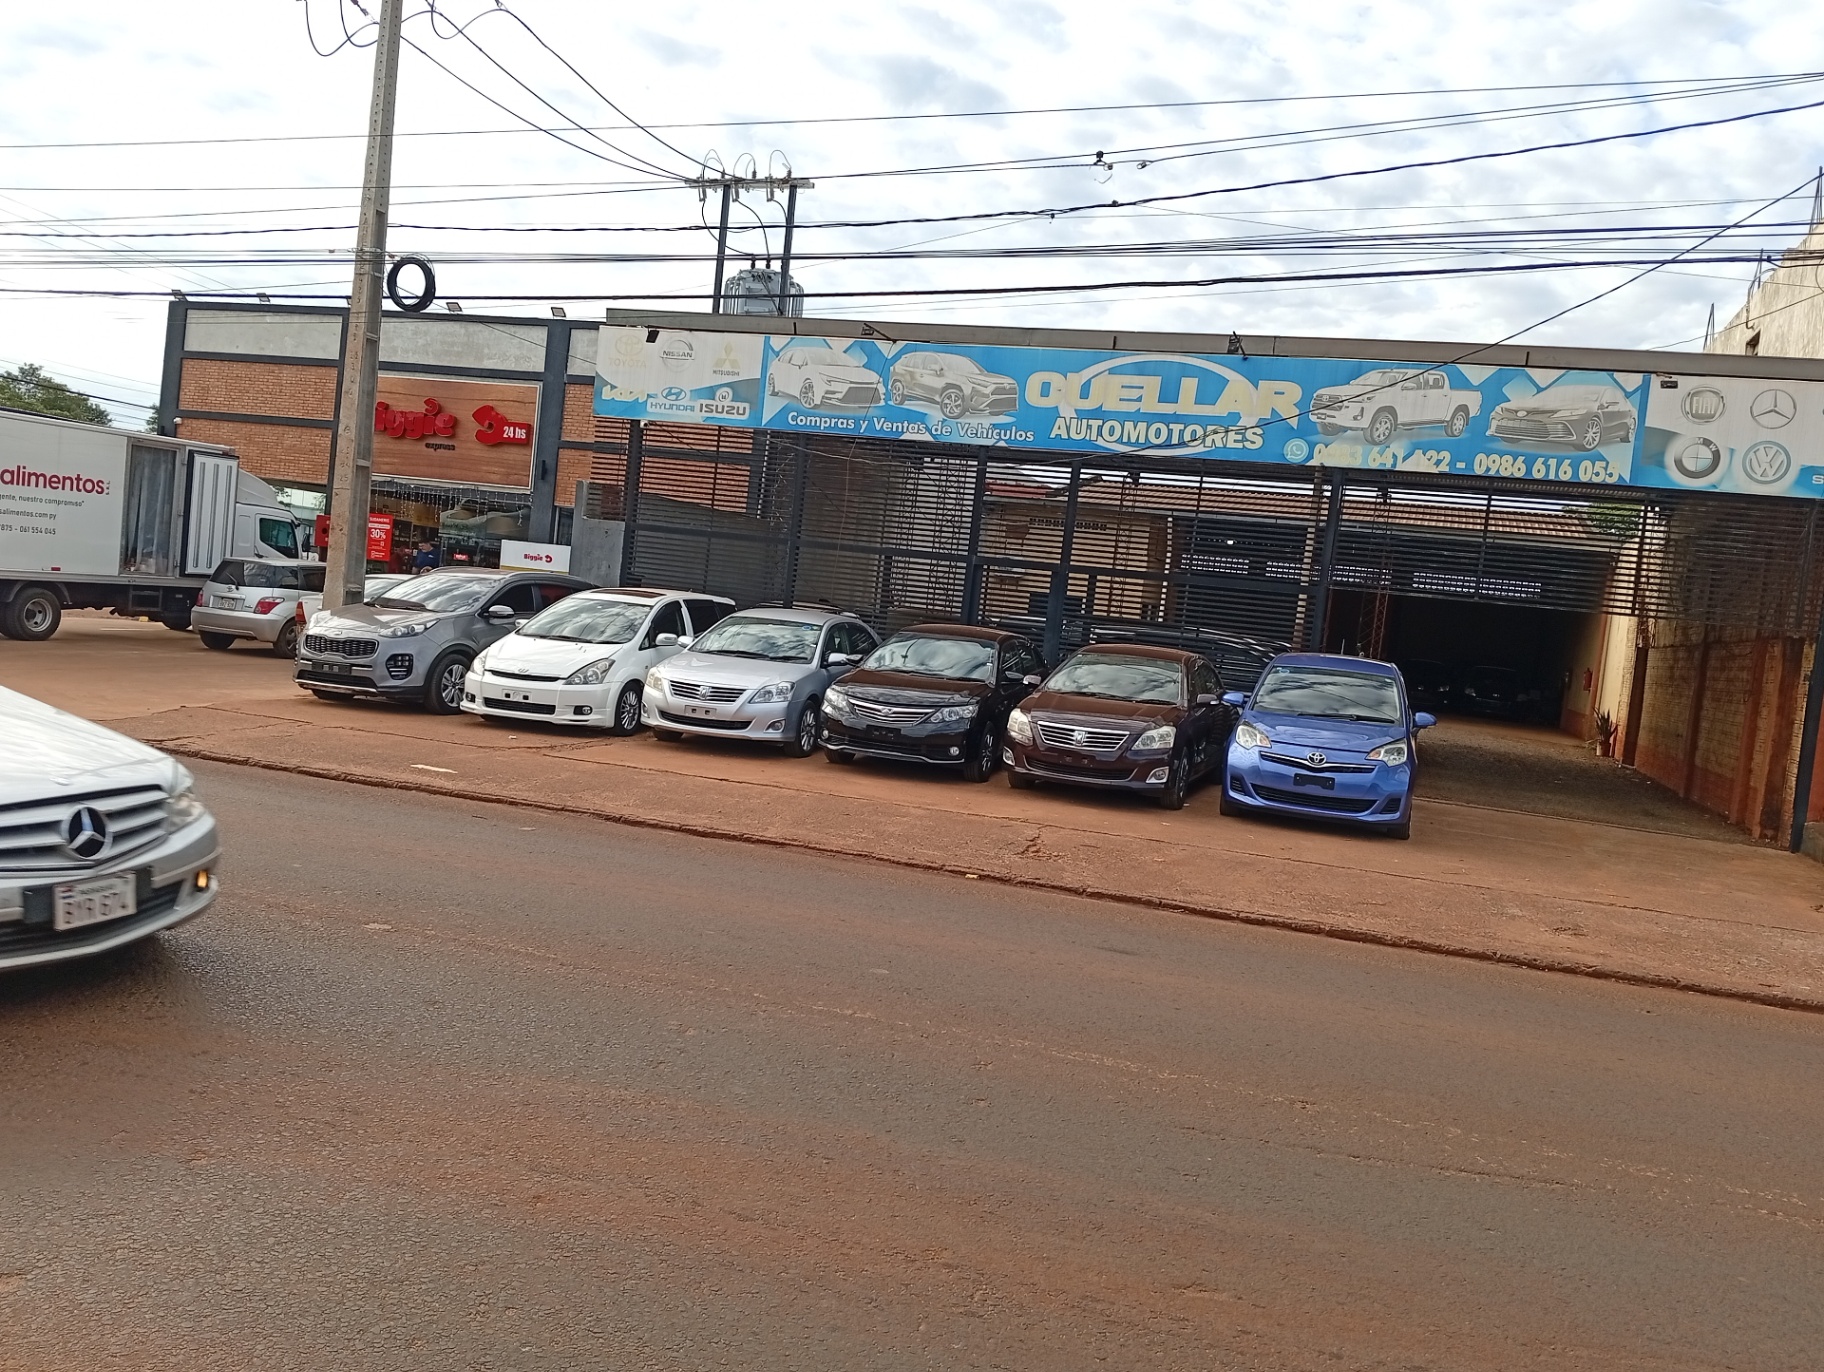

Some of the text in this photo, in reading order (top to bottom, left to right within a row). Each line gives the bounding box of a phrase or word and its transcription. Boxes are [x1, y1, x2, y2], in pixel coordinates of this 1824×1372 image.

[662, 350, 693, 358] NISSAN
[608, 357, 646, 369] TOYOTA
[650, 401, 696, 413] HYUNDAI
[699, 403, 747, 416] ISUZU
[1692, 396, 1717, 415] FIAT
[375, 397, 458, 440] iggie
[503, 426, 526, 439] 24 hs
[787, 411, 1035, 442] Compras y Ventas de Vehículos
[1049, 416, 1265, 450] AUTOMOTORES
[1367, 445, 1403, 470] 641
[1473, 452, 1527, 478] 0986
[1531, 457, 1573, 481] 616
[1578, 459, 1621, 484] 055
[0, 465, 105, 495] alimentos
[19, 495, 44, 504] nuestro
[370, 528, 387, 539] 30%
[523, 553, 544, 562] Biggie
